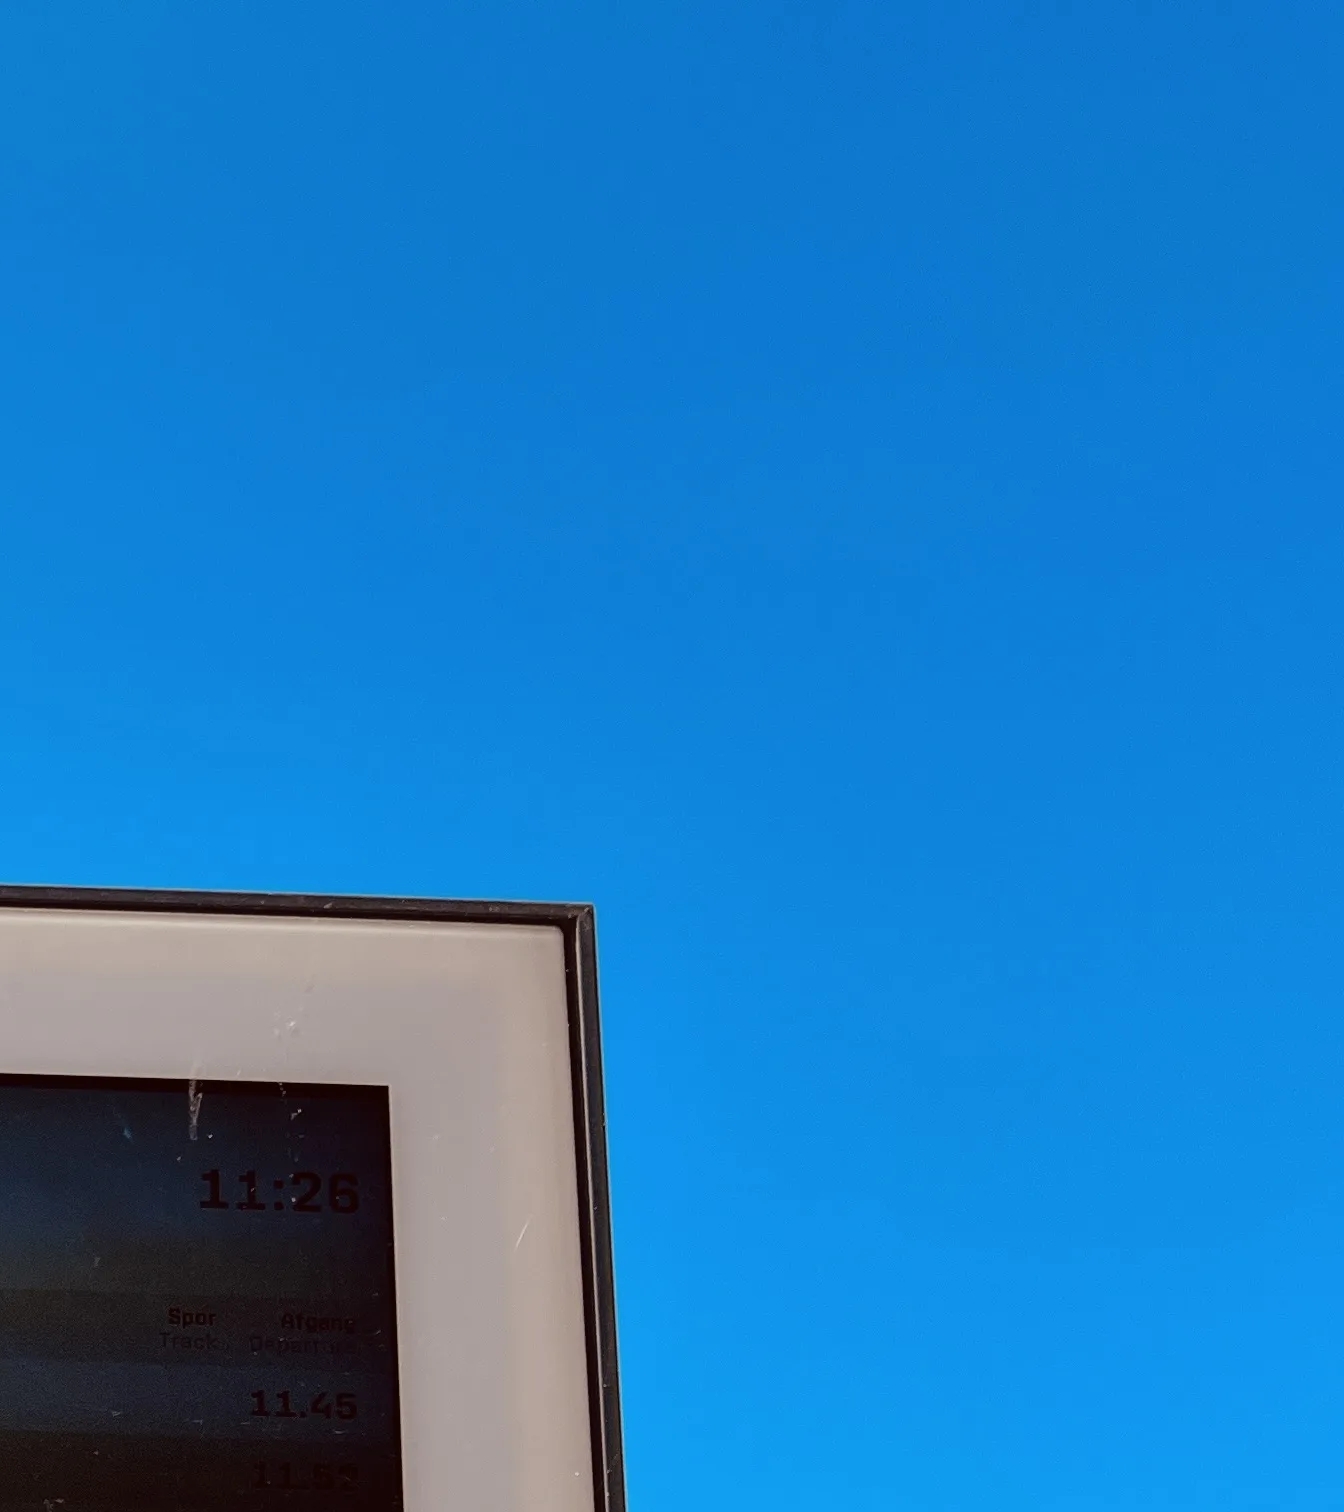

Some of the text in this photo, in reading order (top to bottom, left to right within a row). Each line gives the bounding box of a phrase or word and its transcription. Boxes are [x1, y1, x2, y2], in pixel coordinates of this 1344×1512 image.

[199, 1168, 360, 1214] 11:26
[167, 1305, 217, 1327] Spor
[250, 1389, 358, 1420] 11.45
